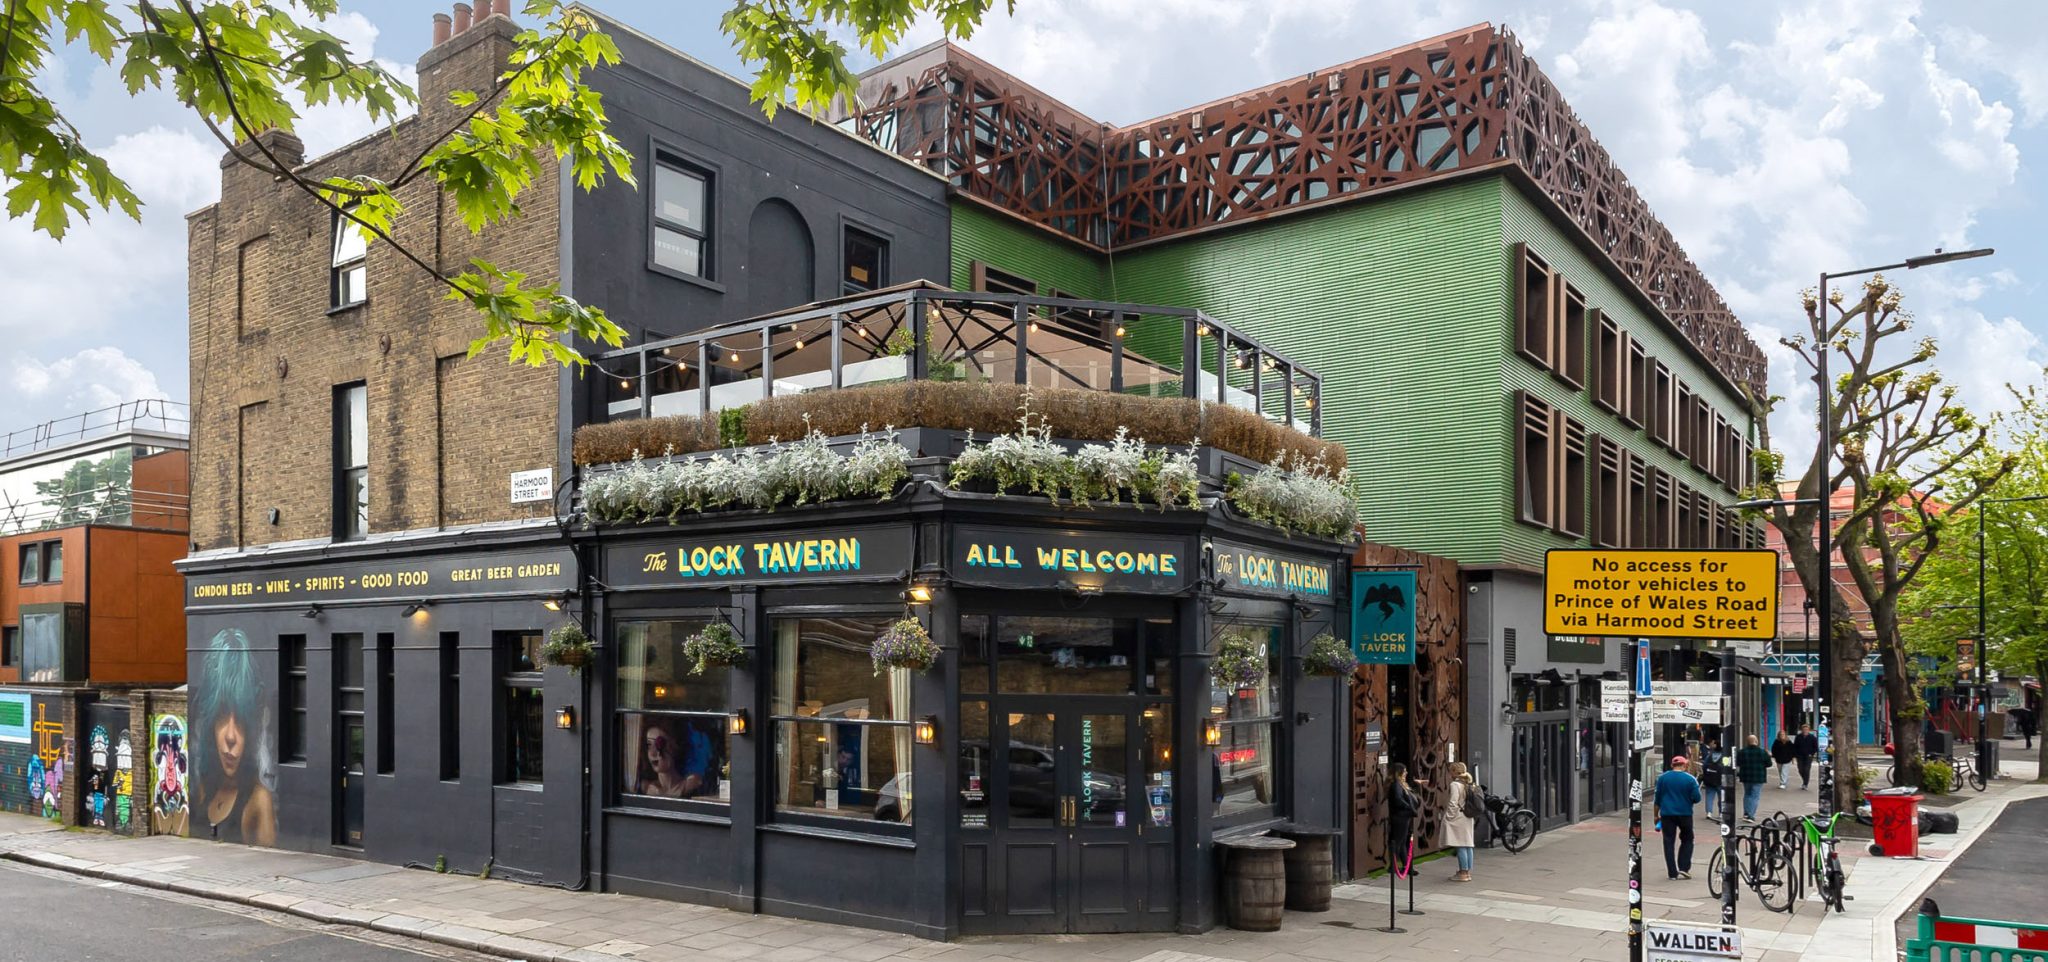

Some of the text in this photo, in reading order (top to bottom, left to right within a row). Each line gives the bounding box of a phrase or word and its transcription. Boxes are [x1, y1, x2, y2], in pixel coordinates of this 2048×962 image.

[514, 477, 548, 488] HARMOOD
[514, 489, 538, 499] STREET
[643, 538, 861, 577] The LOCK TAVERN
[967, 544, 1178, 576] ALL WELCOME
[1592, 558, 1728, 573] No access for
[451, 563, 560, 581] GREAT BEER GARDEN
[1217, 553, 1329, 595] The LOCK TAVERN
[195, 584, 228, 597] LONDON
[231, 583, 253, 596] BEER
[266, 580, 290, 593] WINE
[306, 576, 345, 591] SPIRITS
[362, 574, 392, 588] GOOD
[398, 571, 429, 586] FOOD
[1574, 577, 1746, 592] motor vehicles to
[1554, 593, 1767, 612] Prince of Wales Road
[1561, 613, 1758, 630] via Harmood Street
[1374, 633, 1406, 642] LOCK
[1360, 643, 1406, 652] TAVERN
[1604, 684, 1629, 692] Kentish
[1083, 720, 1092, 766] TAVERN
[1083, 771, 1092, 803] LOCK
[1650, 931, 1731, 952] WALDEN
